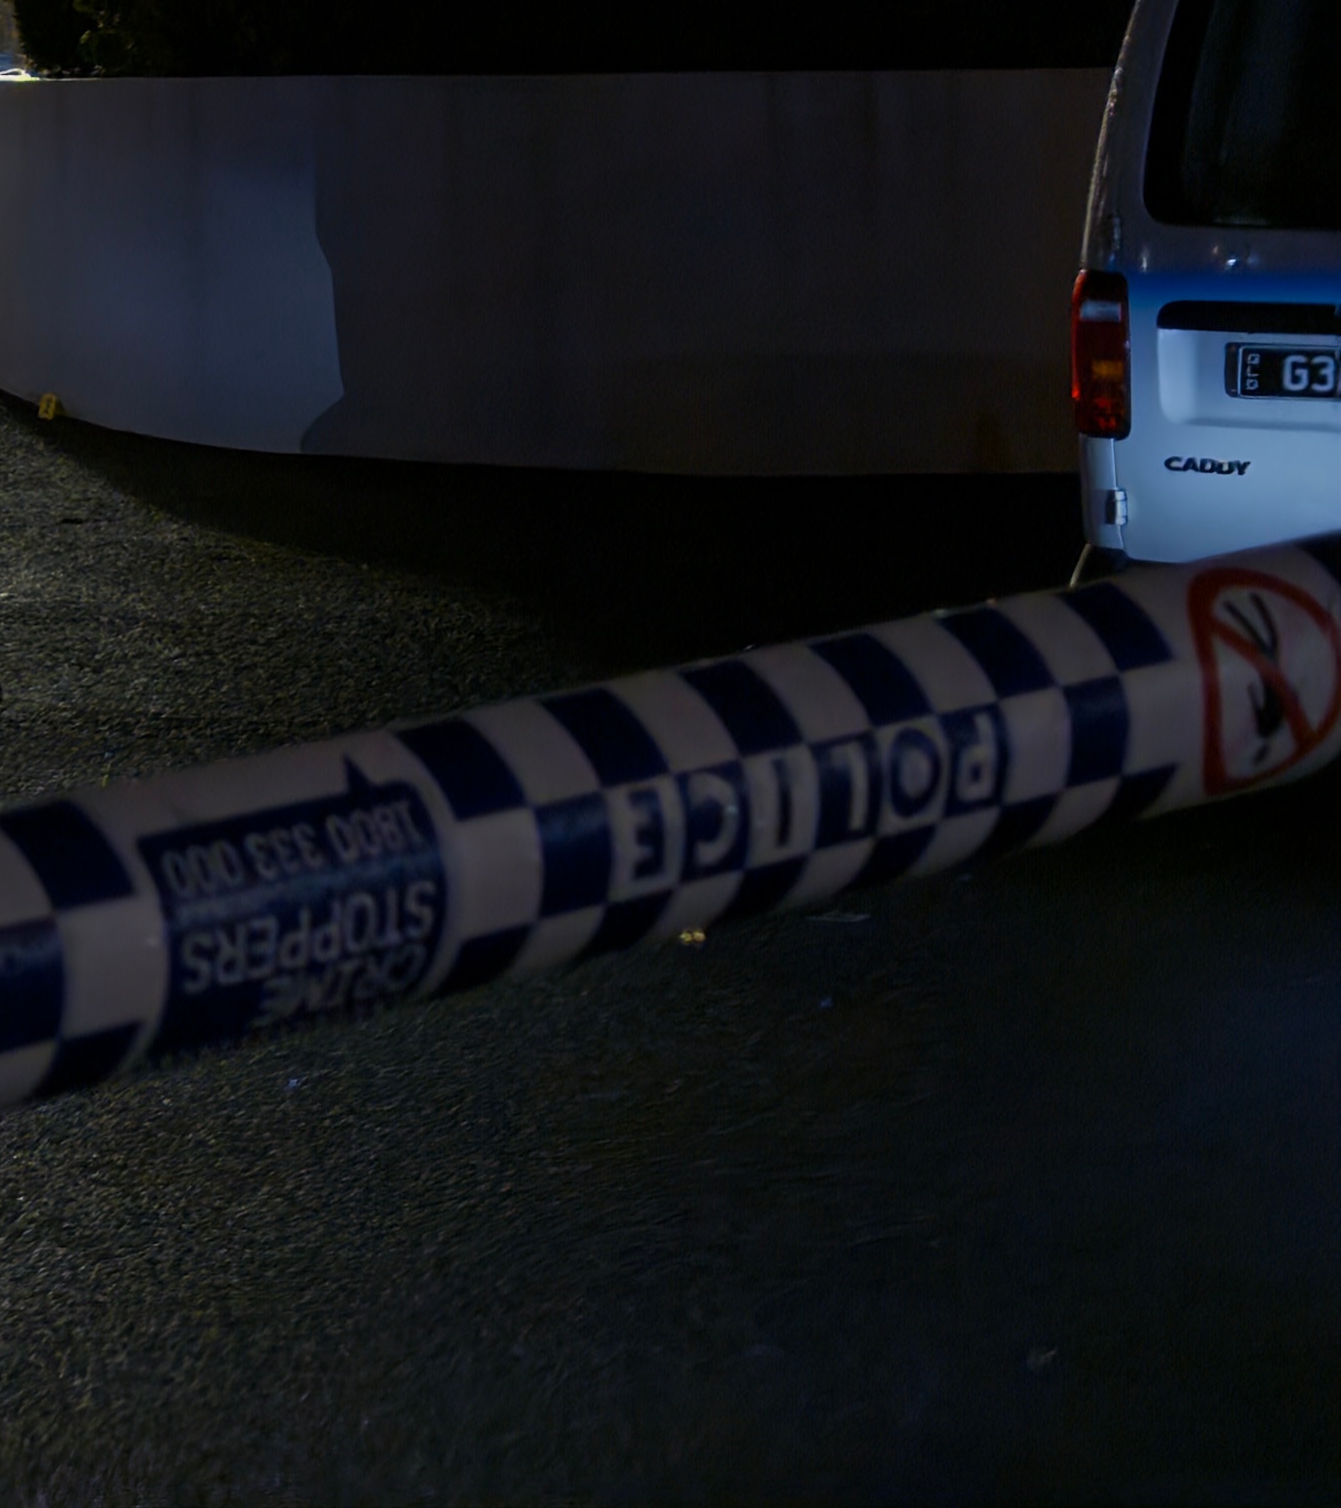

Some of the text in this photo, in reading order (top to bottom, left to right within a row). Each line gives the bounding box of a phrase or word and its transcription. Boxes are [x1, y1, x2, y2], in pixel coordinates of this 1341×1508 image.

[1164, 455, 1251, 476] CADDY
[159, 798, 425, 900] 1800 333 000
[630, 709, 995, 882] POLICE
[180, 878, 438, 996] STOPPERS
